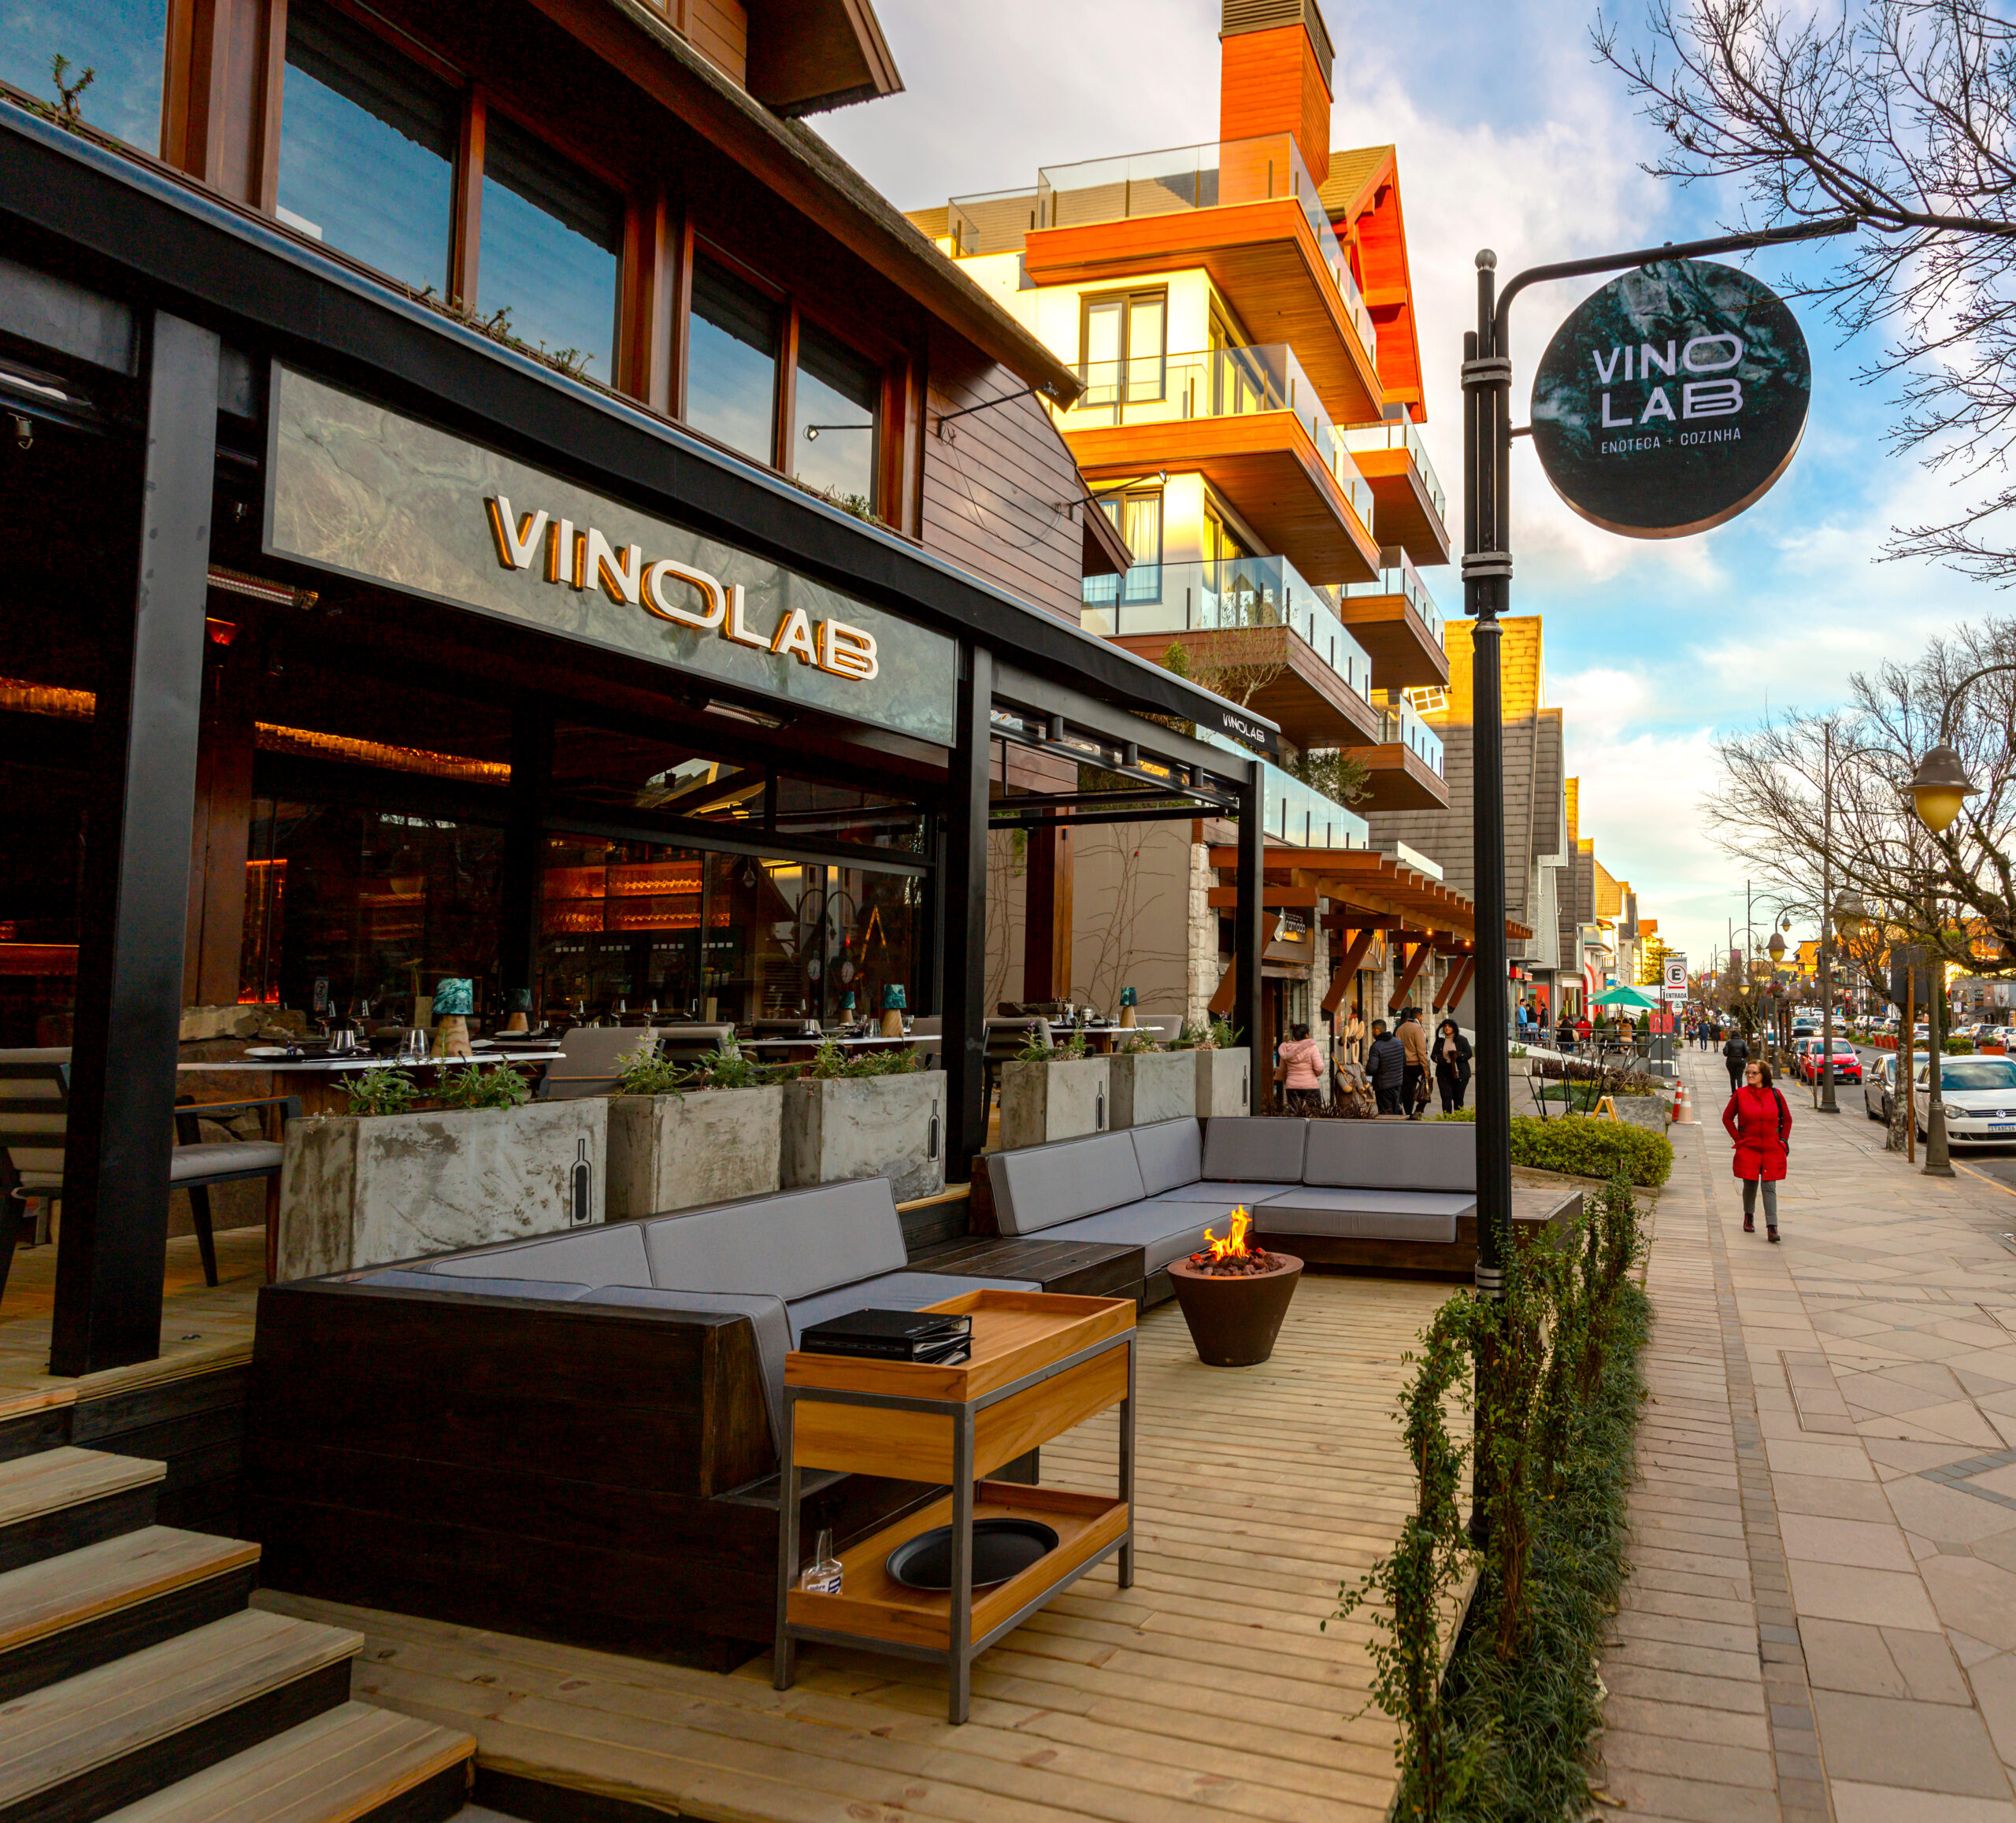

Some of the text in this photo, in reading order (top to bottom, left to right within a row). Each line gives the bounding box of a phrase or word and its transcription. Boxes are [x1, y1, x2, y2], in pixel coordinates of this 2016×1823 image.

[1592, 333, 1744, 383] VINO
[1602, 379, 1744, 428] LAB
[1601, 436, 1661, 454] ENOTECA
[1680, 428, 1742, 446] COZINHA
[490, 495, 880, 680] VINOLAB
[1222, 713, 1266, 743] VINOLAB
[1672, 969, 1681, 980] E
